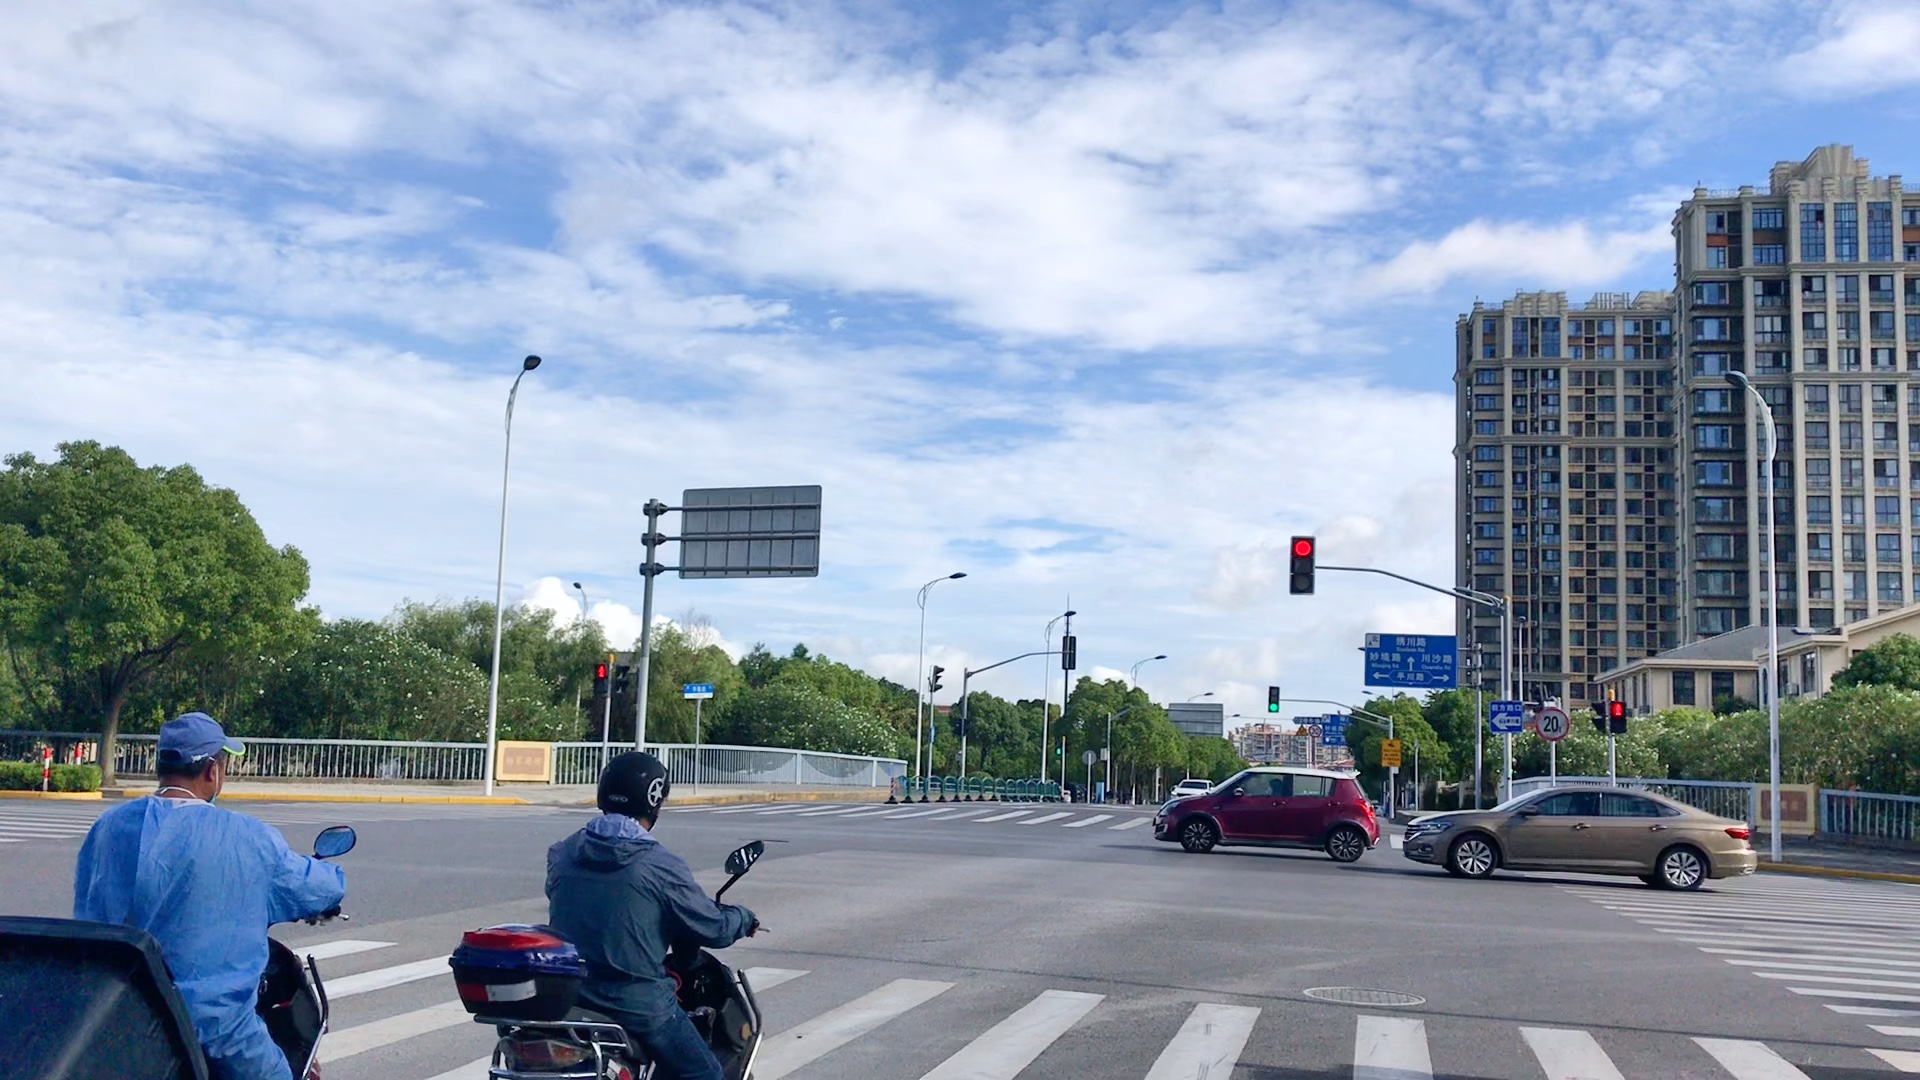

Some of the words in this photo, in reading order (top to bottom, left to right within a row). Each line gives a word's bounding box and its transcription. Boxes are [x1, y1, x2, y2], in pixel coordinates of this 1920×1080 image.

[1369, 652, 1401, 662] 妙境路
[1421, 653, 1453, 664] 川沙路
[1397, 672, 1425, 681] 平川路
[1491, 704, 1521, 712] 前方路口
